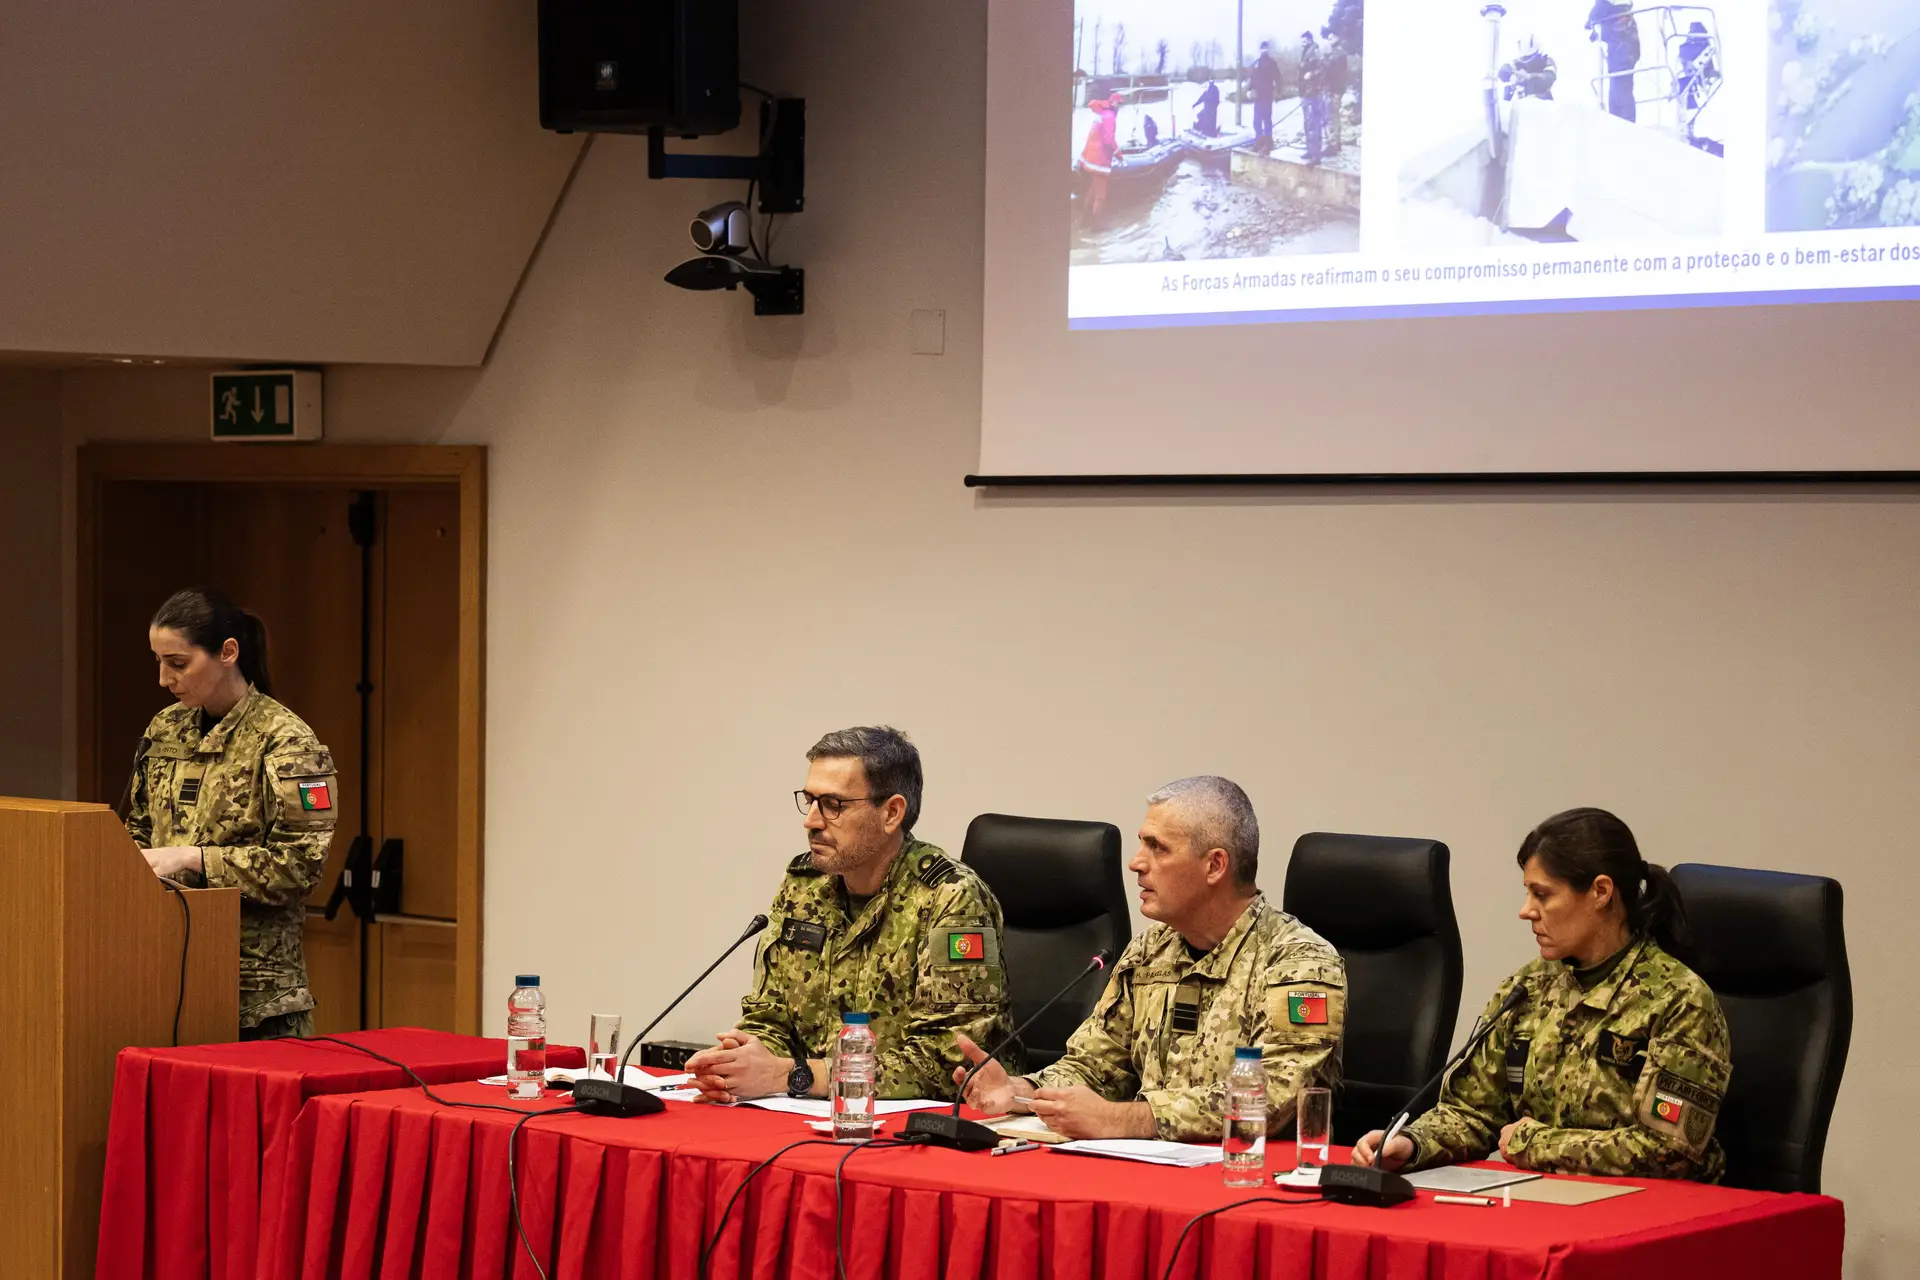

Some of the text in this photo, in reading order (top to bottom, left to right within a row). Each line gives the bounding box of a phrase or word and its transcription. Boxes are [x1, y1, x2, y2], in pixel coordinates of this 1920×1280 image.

[1161, 275, 1178, 292] As
[1232, 271, 1297, 289] Armadas
[1301, 267, 1378, 285] reafirmam
[1382, 269, 1390, 282] o
[1394, 267, 1420, 282] seu
[1425, 258, 1528, 282] compromisso
[1532, 255, 1629, 279] permanente
[1633, 256, 1667, 271] com
[1672, 255, 1681, 270] a
[1687, 250, 1761, 273] proteção
[1766, 252, 1775, 266] e
[1780, 251, 1789, 265] o
[1890, 242, 1920, 261] dos
[580, 1084, 610, 1097] BOSCH
[914, 1118, 946, 1132] BOSCH
[1330, 1169, 1369, 1187] BOSCH
